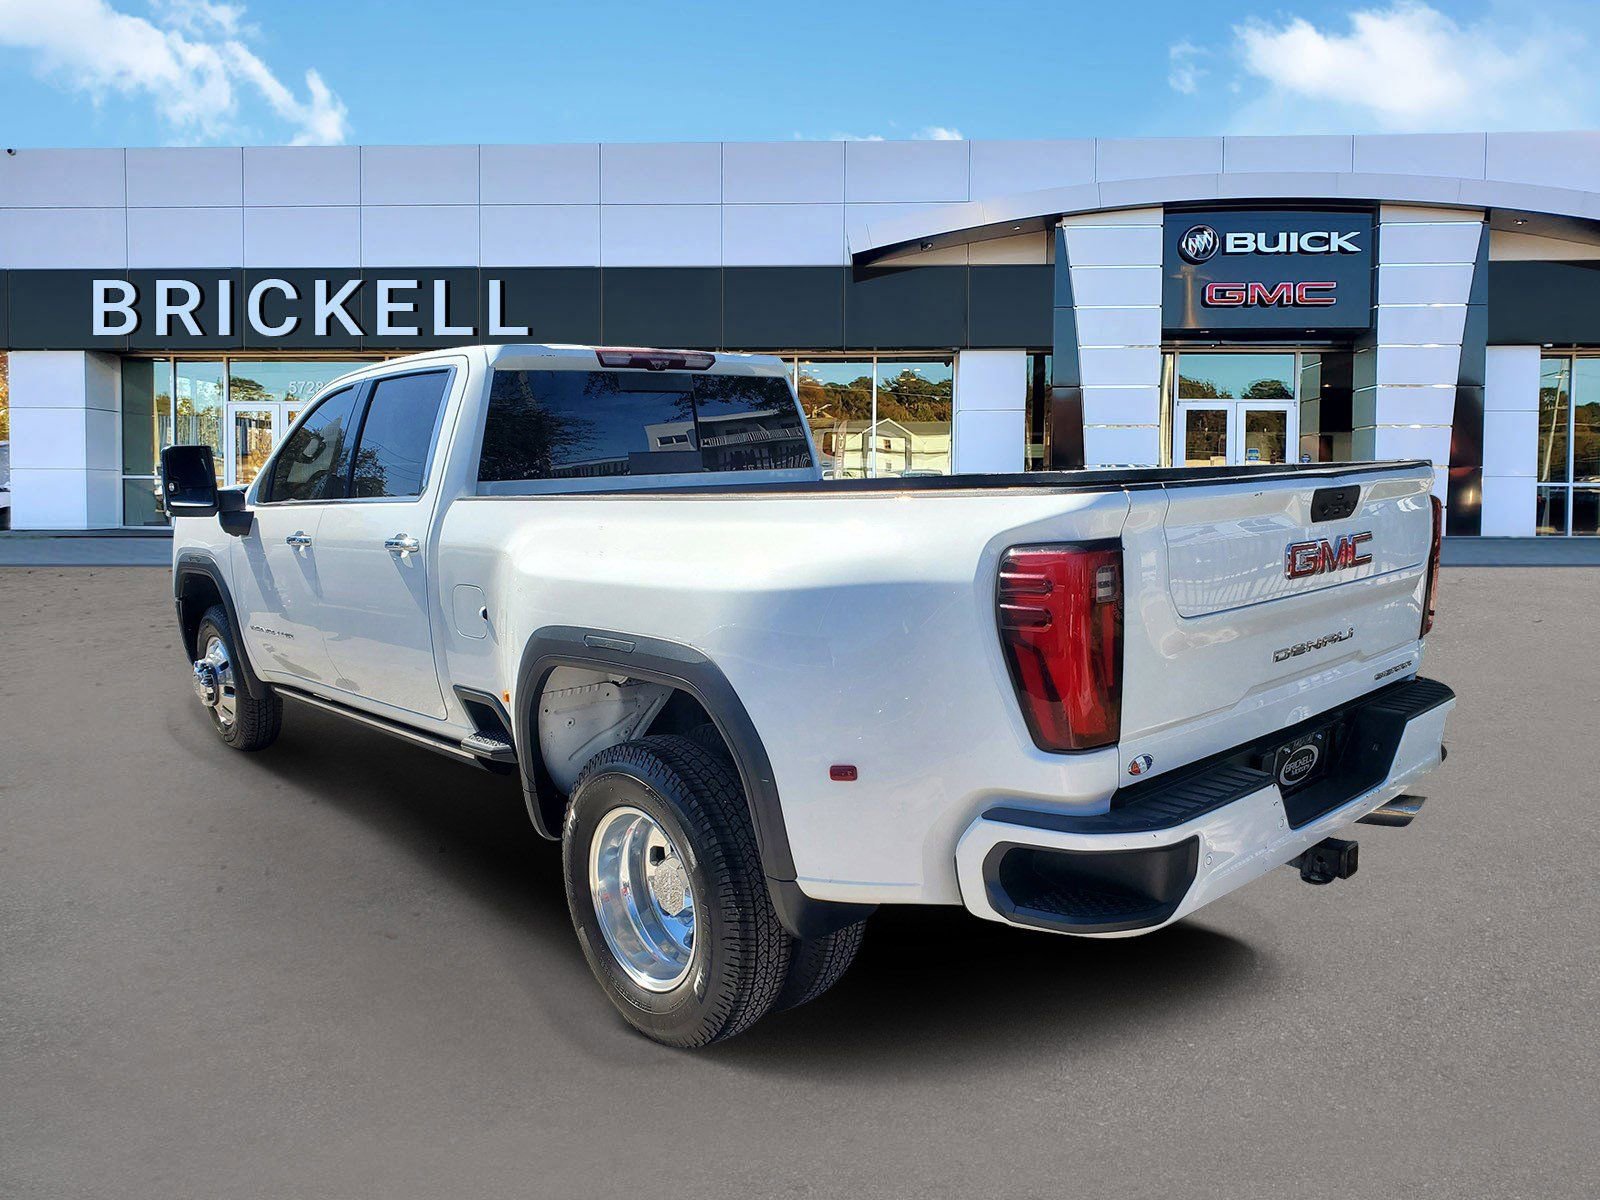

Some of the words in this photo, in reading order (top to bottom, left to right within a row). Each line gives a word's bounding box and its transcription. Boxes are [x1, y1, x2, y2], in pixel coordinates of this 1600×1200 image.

[1226, 231, 1362, 253] BUICK
[92, 279, 531, 337] BRICKELL
[1205, 282, 1337, 305] GMC
[1285, 531, 1373, 580] GMC
